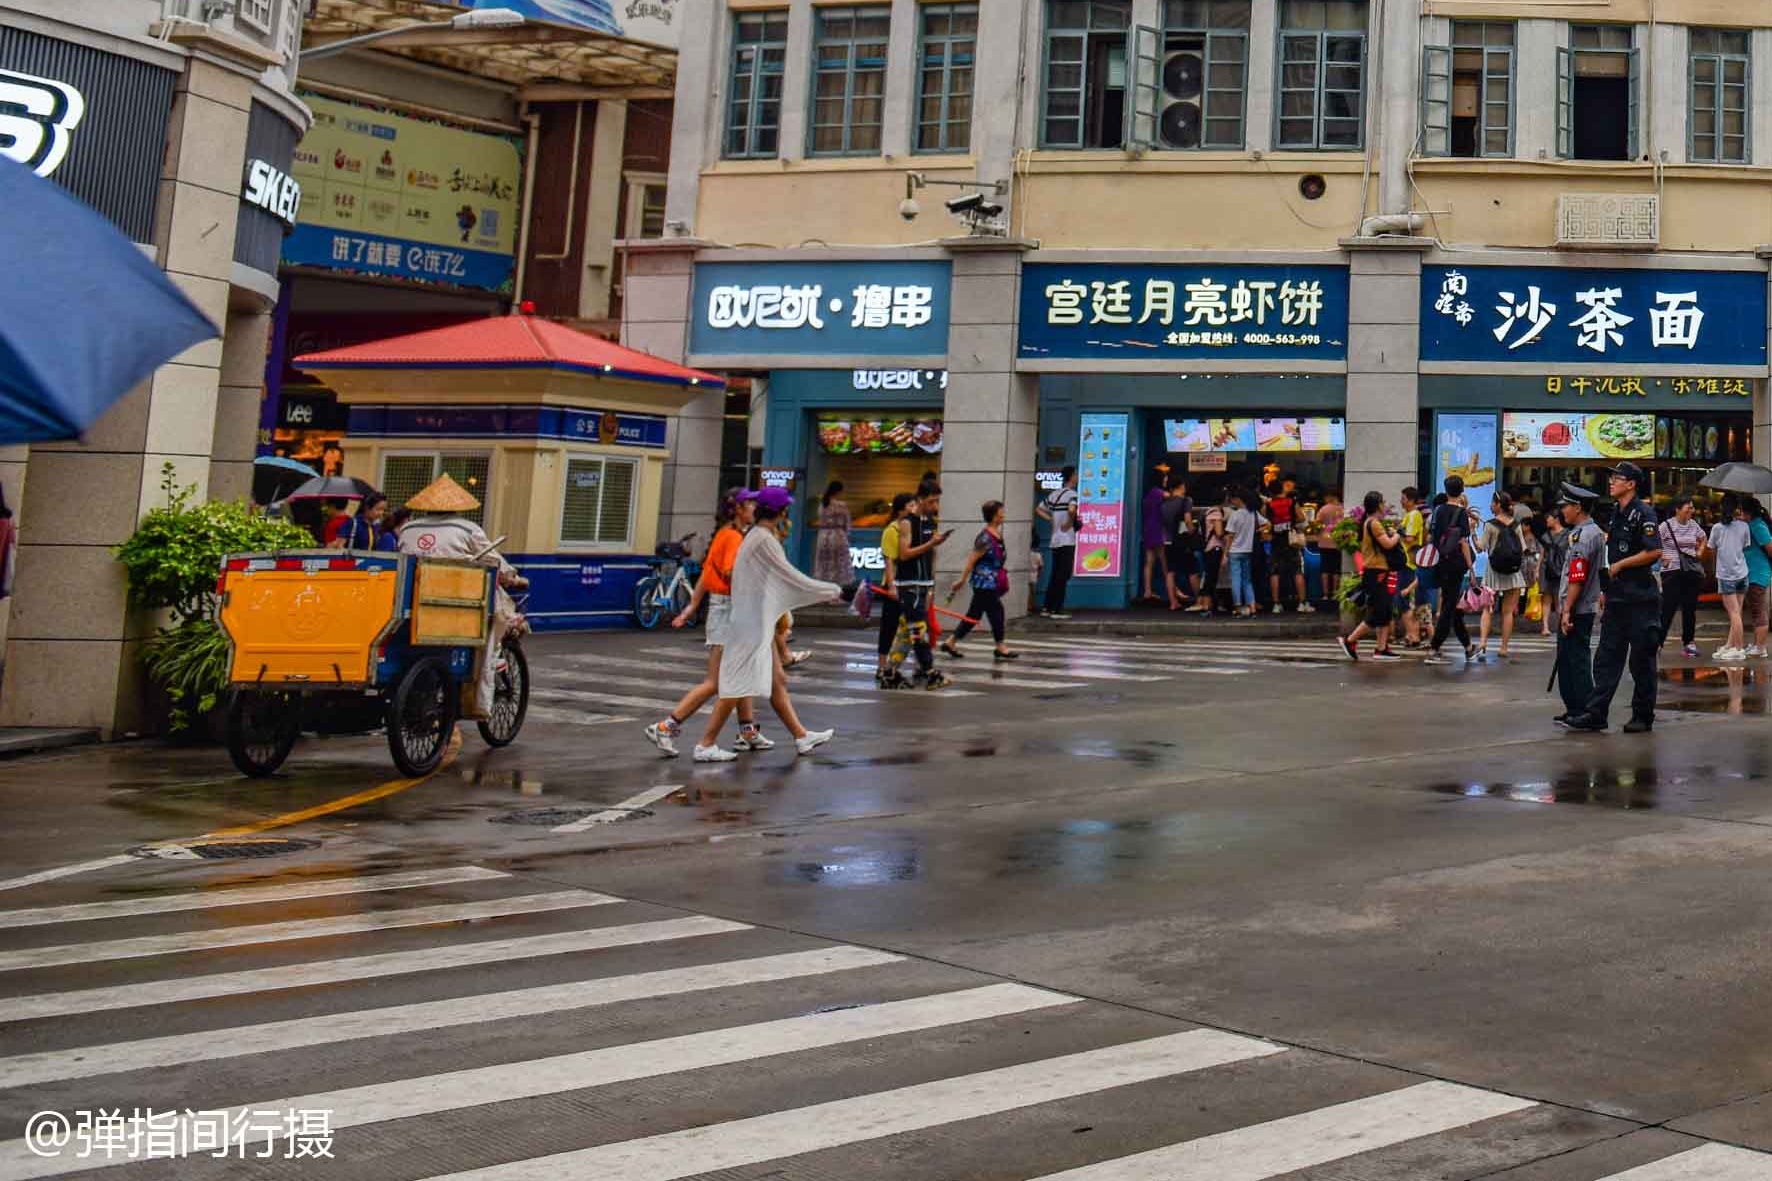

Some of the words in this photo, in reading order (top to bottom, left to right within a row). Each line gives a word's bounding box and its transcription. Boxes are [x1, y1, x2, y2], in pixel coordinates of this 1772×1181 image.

[1046, 278, 1323, 326] 宫廷月亮虾饼
[1493, 286, 1705, 353] 沙茶面
[286, 402, 312, 422] Lee
